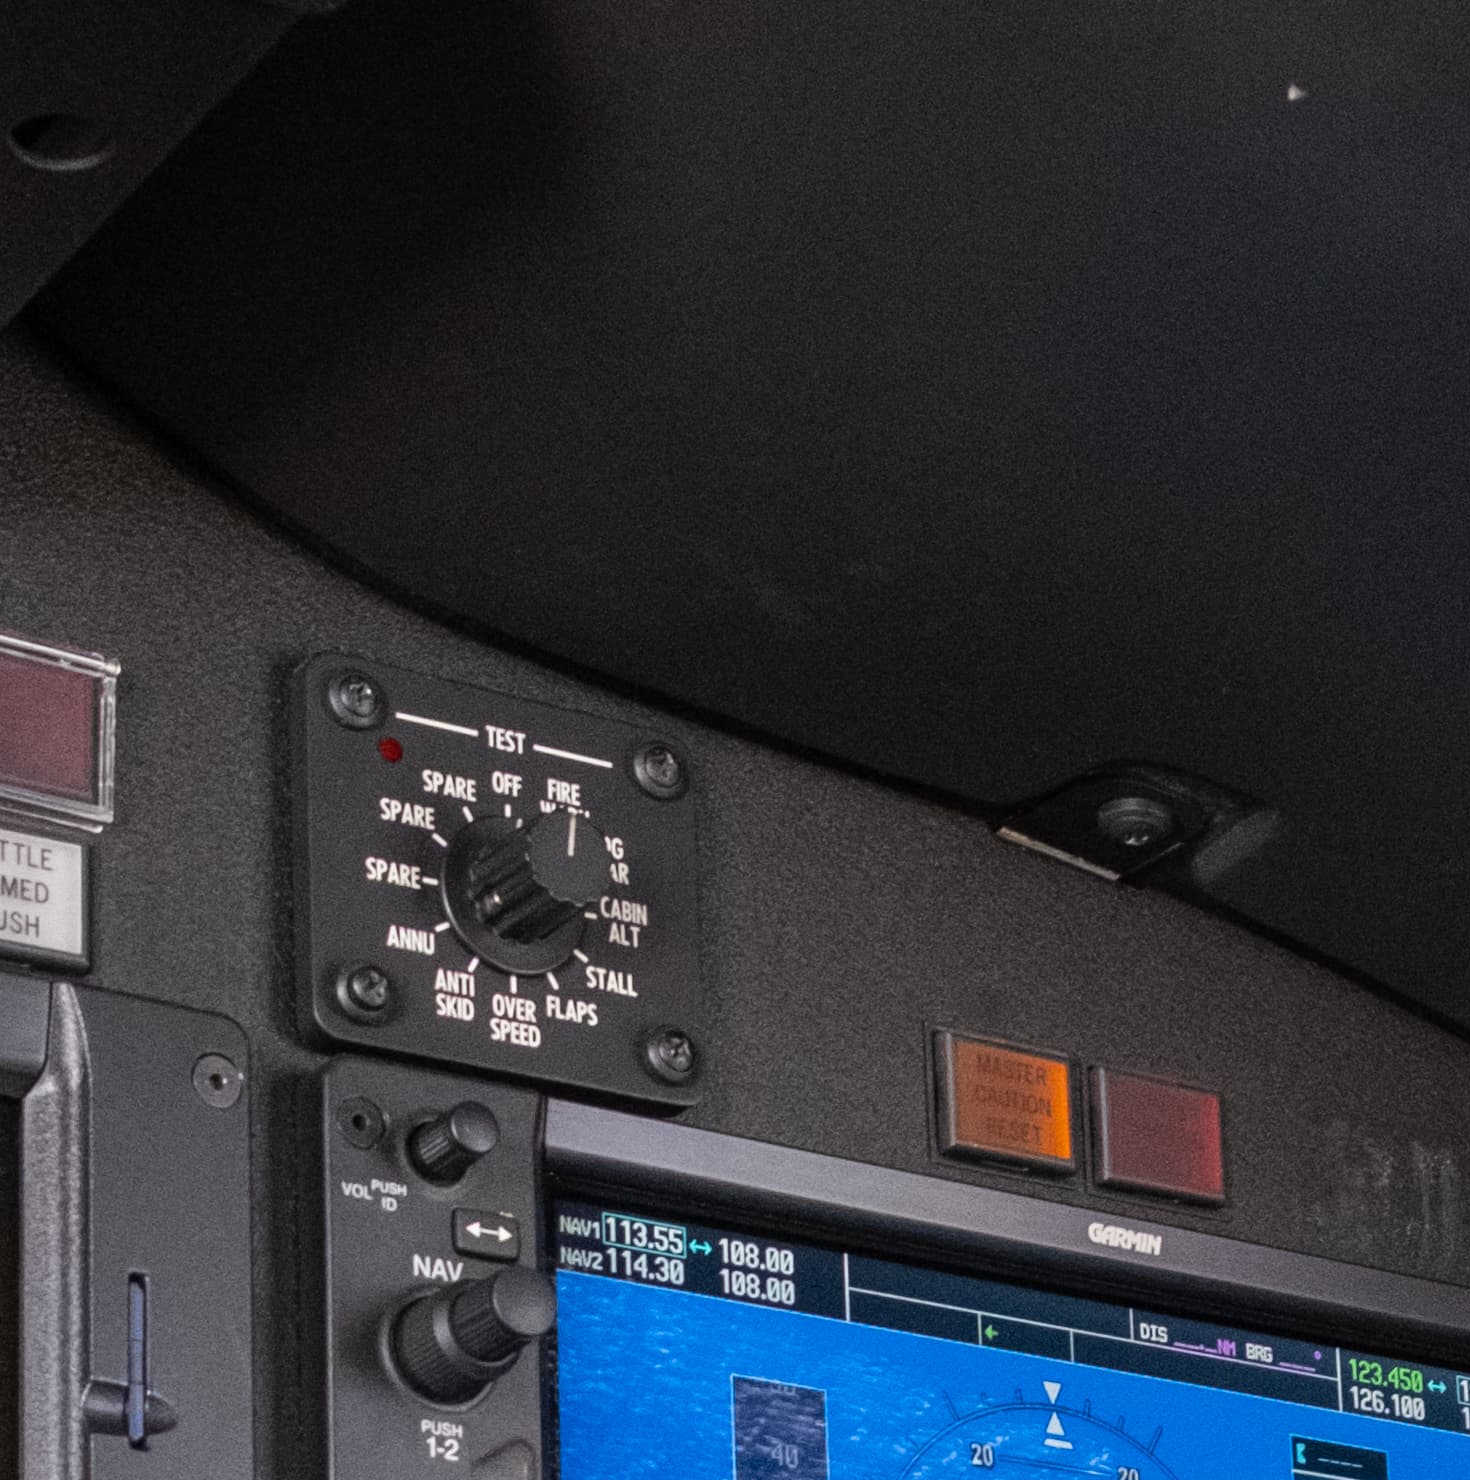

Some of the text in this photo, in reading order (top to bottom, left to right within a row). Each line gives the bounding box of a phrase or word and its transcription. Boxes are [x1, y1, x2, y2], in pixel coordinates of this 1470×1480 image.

[486, 725, 526, 754] TEST
[422, 770, 477, 802] SPARE
[492, 771, 522, 797] OFF
[547, 779, 581, 806] FIRE
[380, 798, 435, 829] SPARE
[365, 857, 421, 889] SPARE
[600, 896, 648, 926] CABIN
[387, 925, 435, 955] ANNU
[609, 926, 640, 948] ALT
[435, 969, 475, 997] ANTI
[586, 966, 638, 998] STALL
[436, 993, 474, 1021] SKID
[492, 993, 536, 1023] OVER
[546, 995, 598, 1026] FLAPS
[490, 1018, 541, 1048] SPEED
[559, 1215, 794, 1275] NAV1 113.55 108.00
[1088, 1222, 1161, 1256] GARMIN
[413, 1254, 464, 1281] NAV
[560, 1247, 795, 1305] NAV2 114.30 108.00
[1140, 1323, 1273, 1363] DIS BRG
[1349, 1358, 1423, 1393] 123.450
[1352, 1386, 1425, 1421] 126.100
